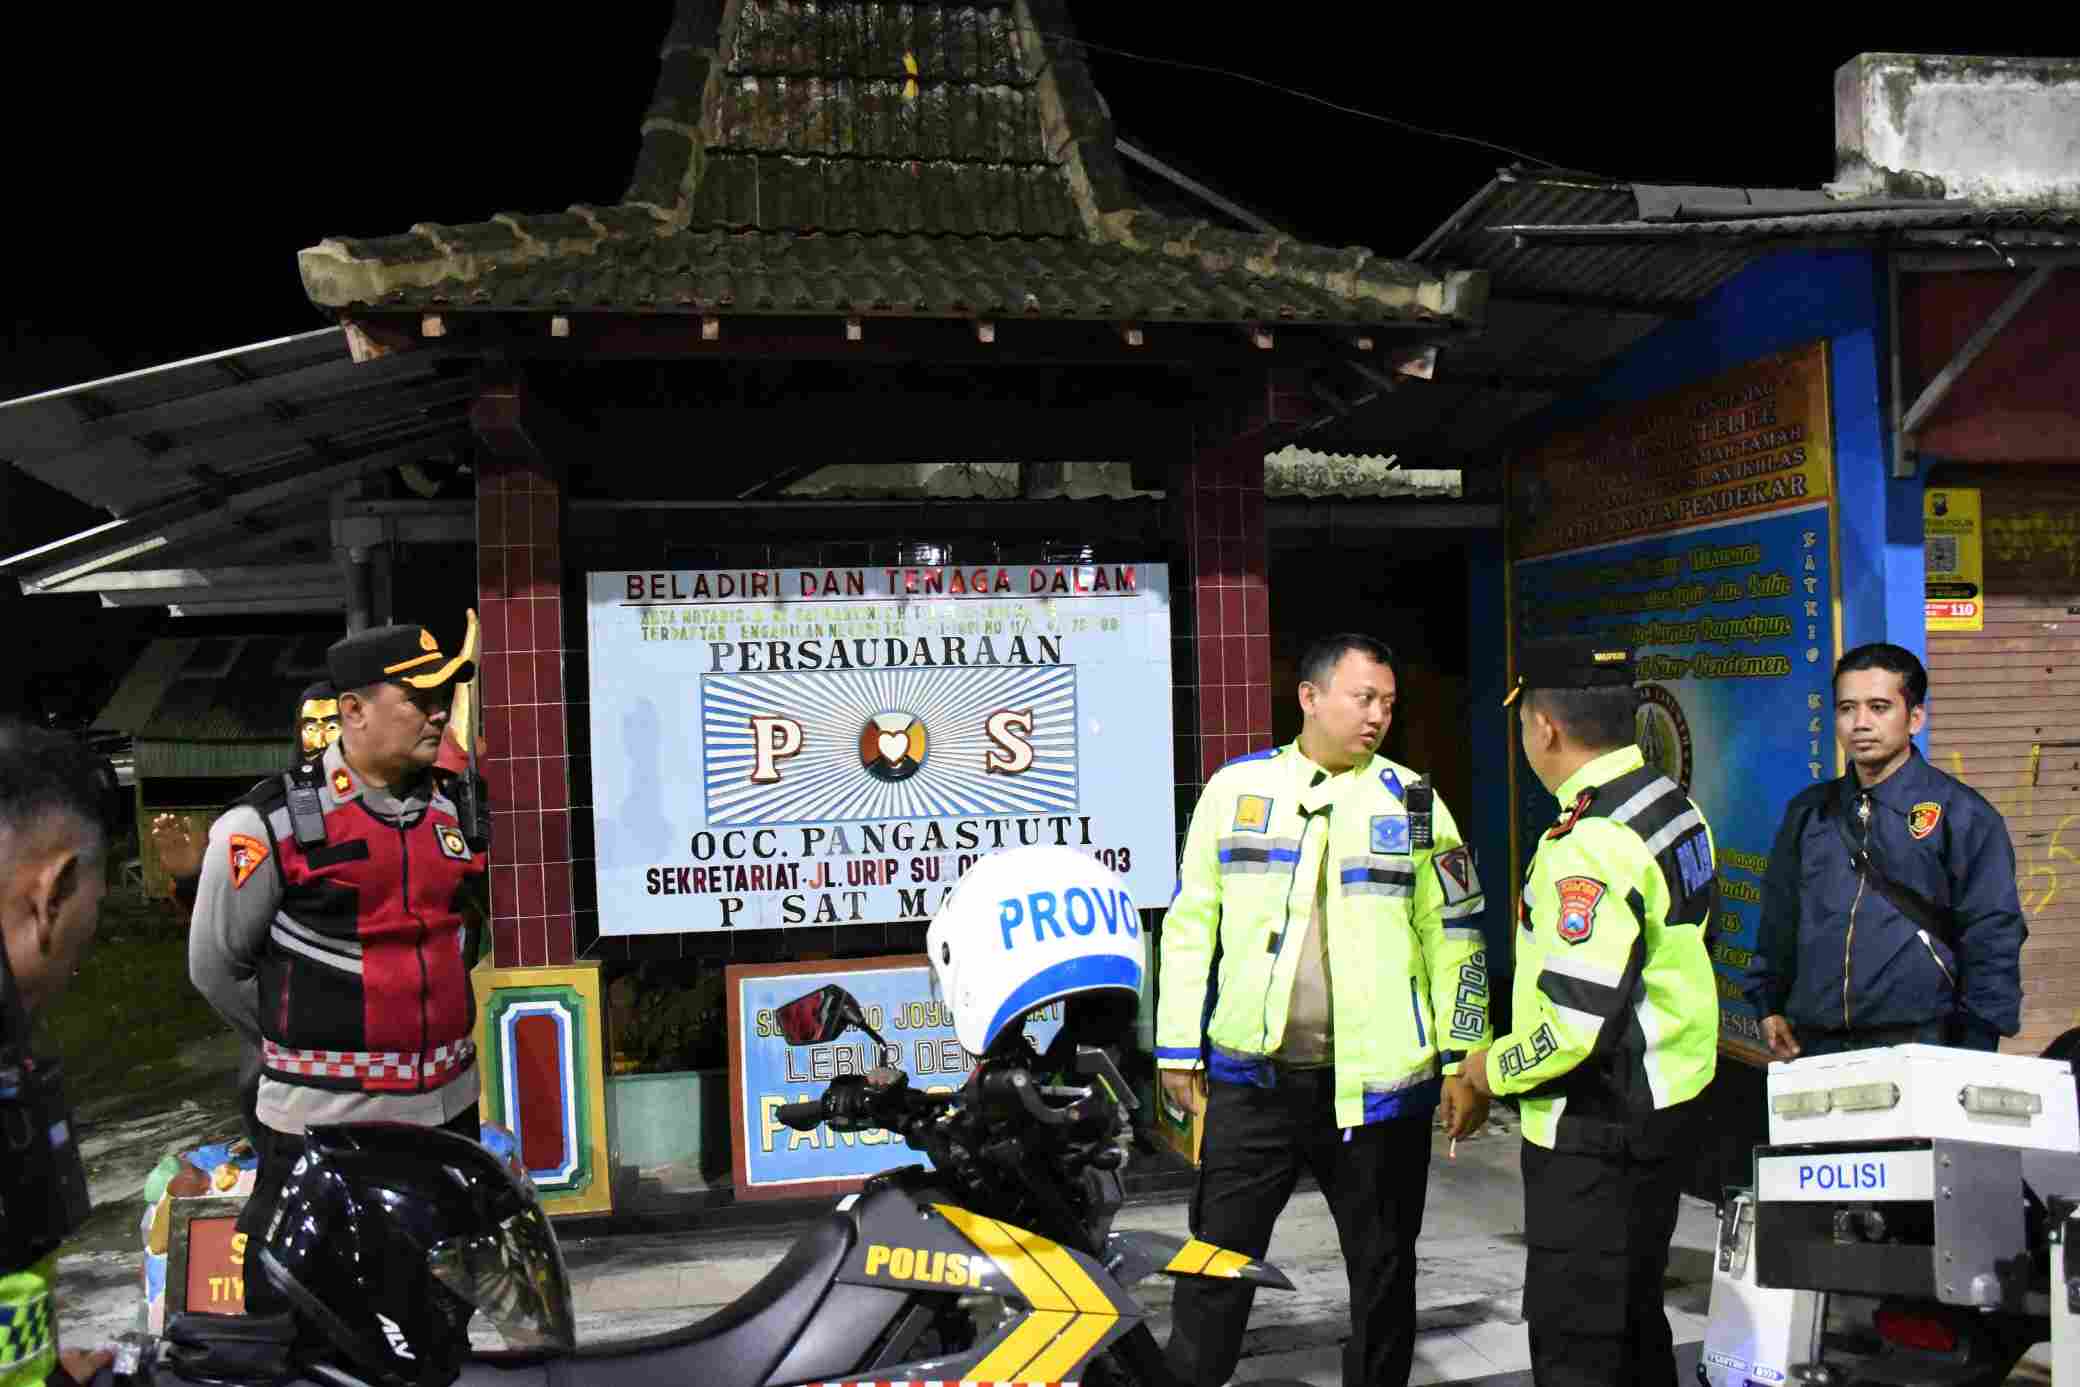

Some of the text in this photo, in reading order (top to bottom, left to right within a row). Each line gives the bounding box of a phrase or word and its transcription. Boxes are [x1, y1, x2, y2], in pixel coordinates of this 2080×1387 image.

[625, 566, 1137, 600] BELADIRI DAN TENAGA DALAM
[708, 635, 1063, 672] PERSAUDARAAN
[751, 707, 1035, 784] P S
[690, 816, 1093, 861] OCC. PANGASTUTI
[1450, 950, 1487, 1042] POLISI
[784, 1041, 904, 1084] LEBUR
[1799, 1163, 1886, 1189] POLISI
[865, 1245, 982, 1288] POLISI
